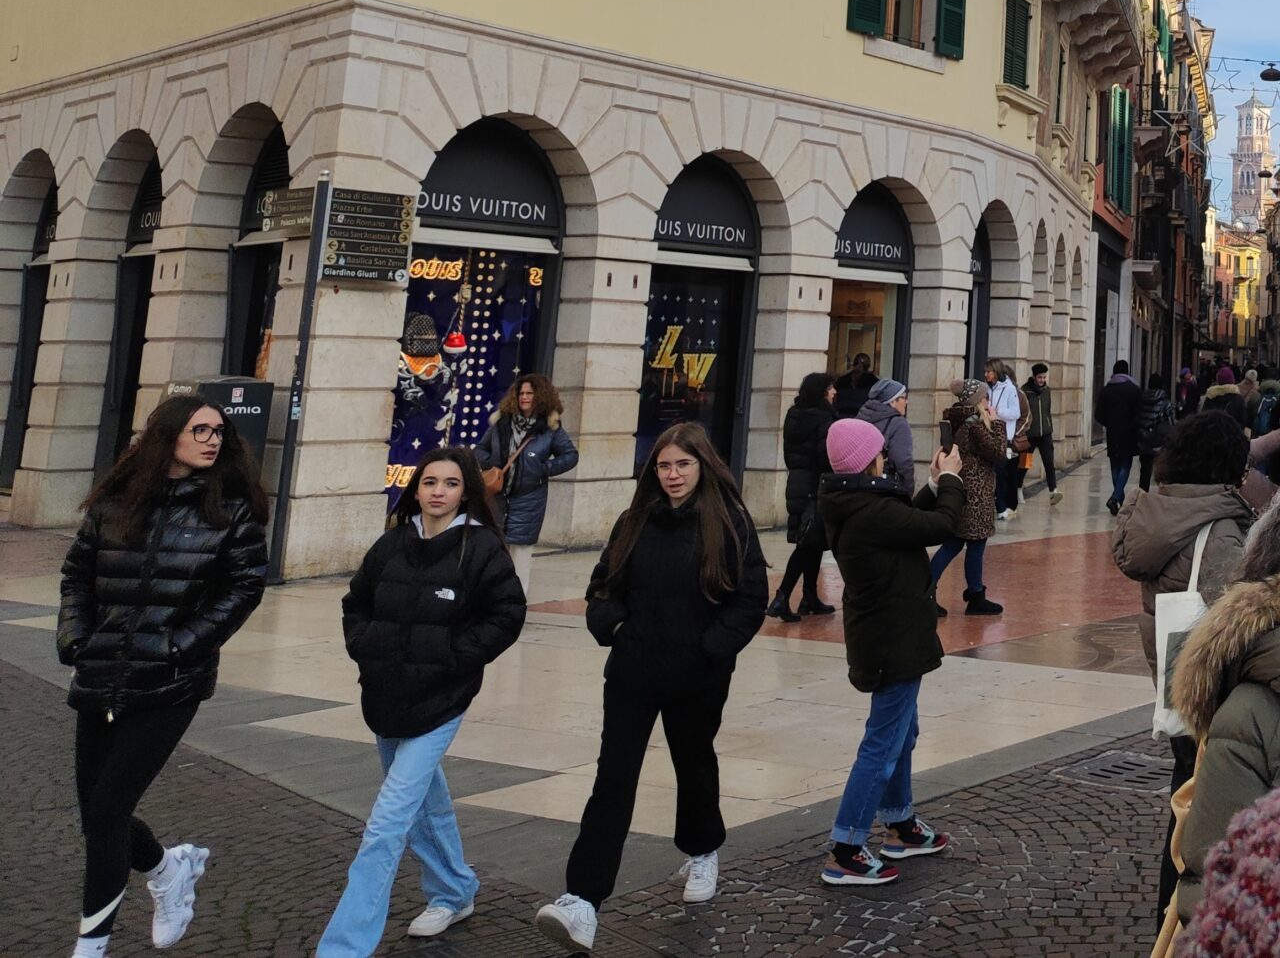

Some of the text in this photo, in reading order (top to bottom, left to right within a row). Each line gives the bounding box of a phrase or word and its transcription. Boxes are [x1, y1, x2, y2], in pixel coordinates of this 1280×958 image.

[334, 190, 352, 199] Casa
[332, 203, 355, 212] Piazza
[417, 191, 547, 221] OUIS VUITTON
[140, 211, 161, 229] LOUI
[332, 216, 355, 225] Ttro
[329, 229, 350, 238] Chiesa
[658, 219, 746, 243] UIS VUITTON
[359, 244, 406, 255] Castelvecchio
[855, 241, 902, 259] VUITTON
[346, 256, 405, 268] Basilica San Zeno
[323, 268, 378, 278] Giardino Giusti
[409, 258, 463, 281] OUIS
[223, 405, 262, 415] amia
